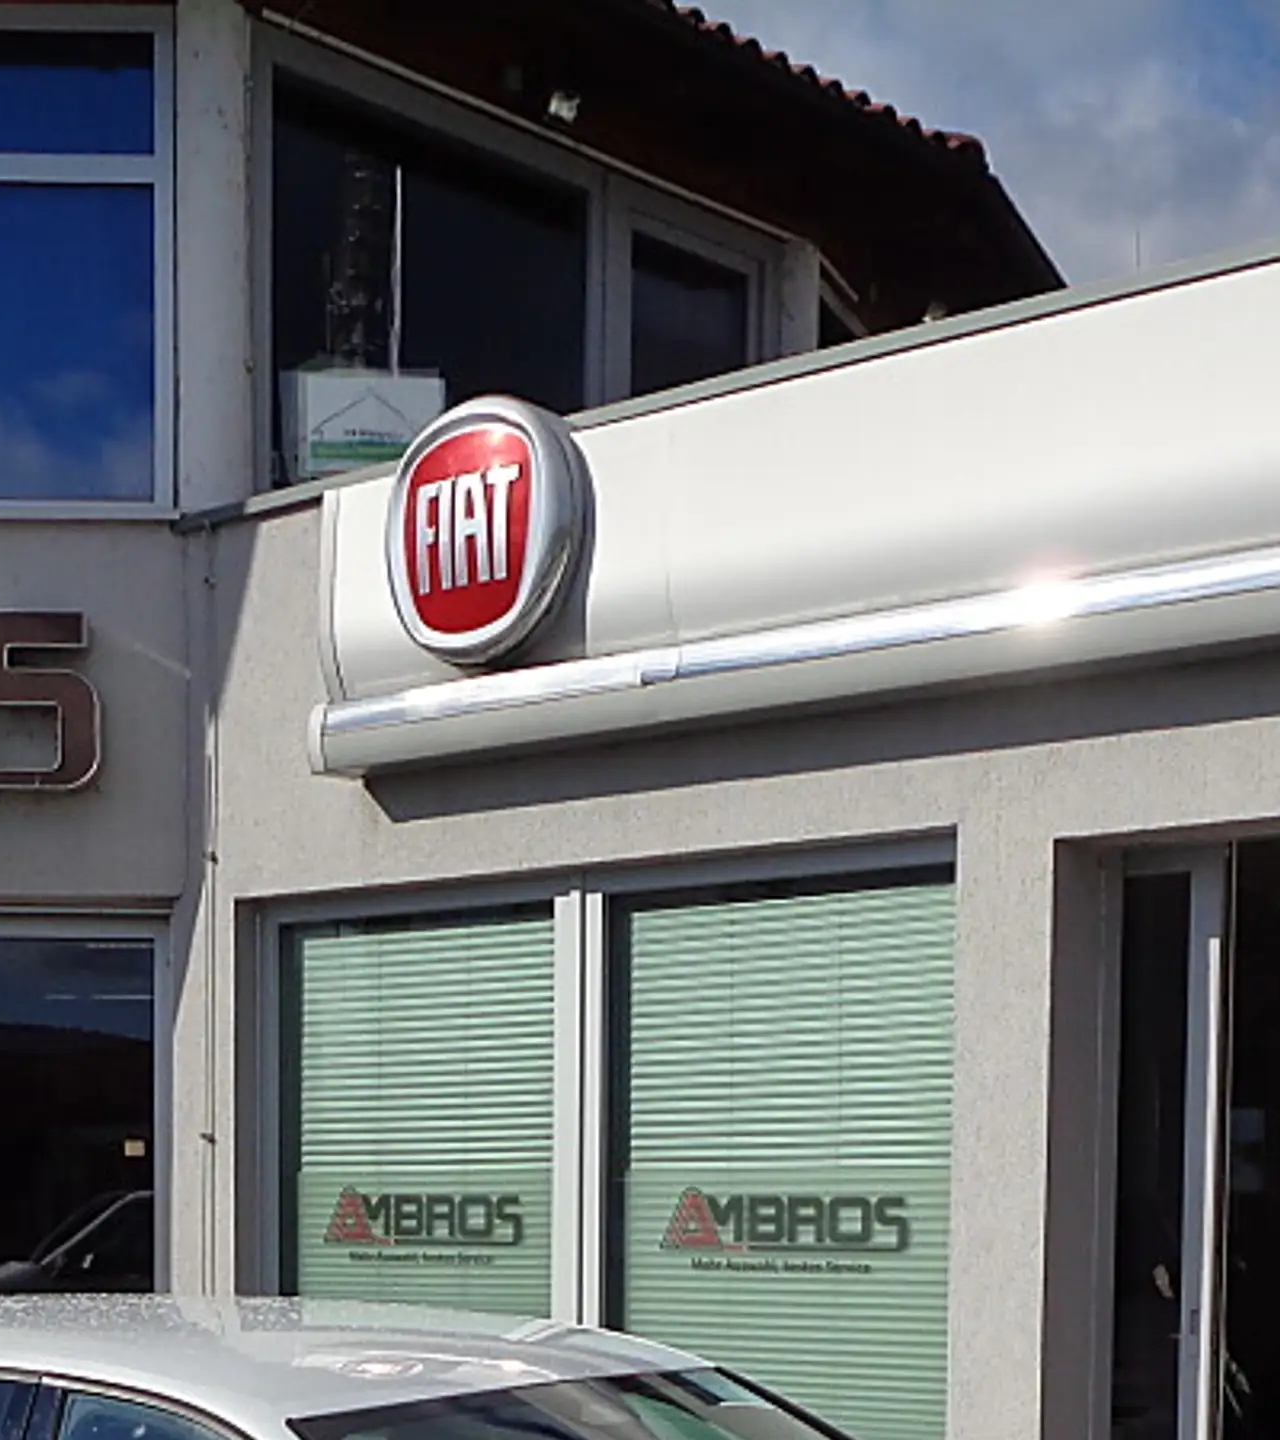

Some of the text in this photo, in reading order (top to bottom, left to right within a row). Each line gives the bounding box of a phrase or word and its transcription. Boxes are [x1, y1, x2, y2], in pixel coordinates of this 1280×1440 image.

[415, 463, 520, 596] FIAT
[323, 1184, 523, 1247] AMBROS
[659, 1186, 910, 1252] AMBROS
